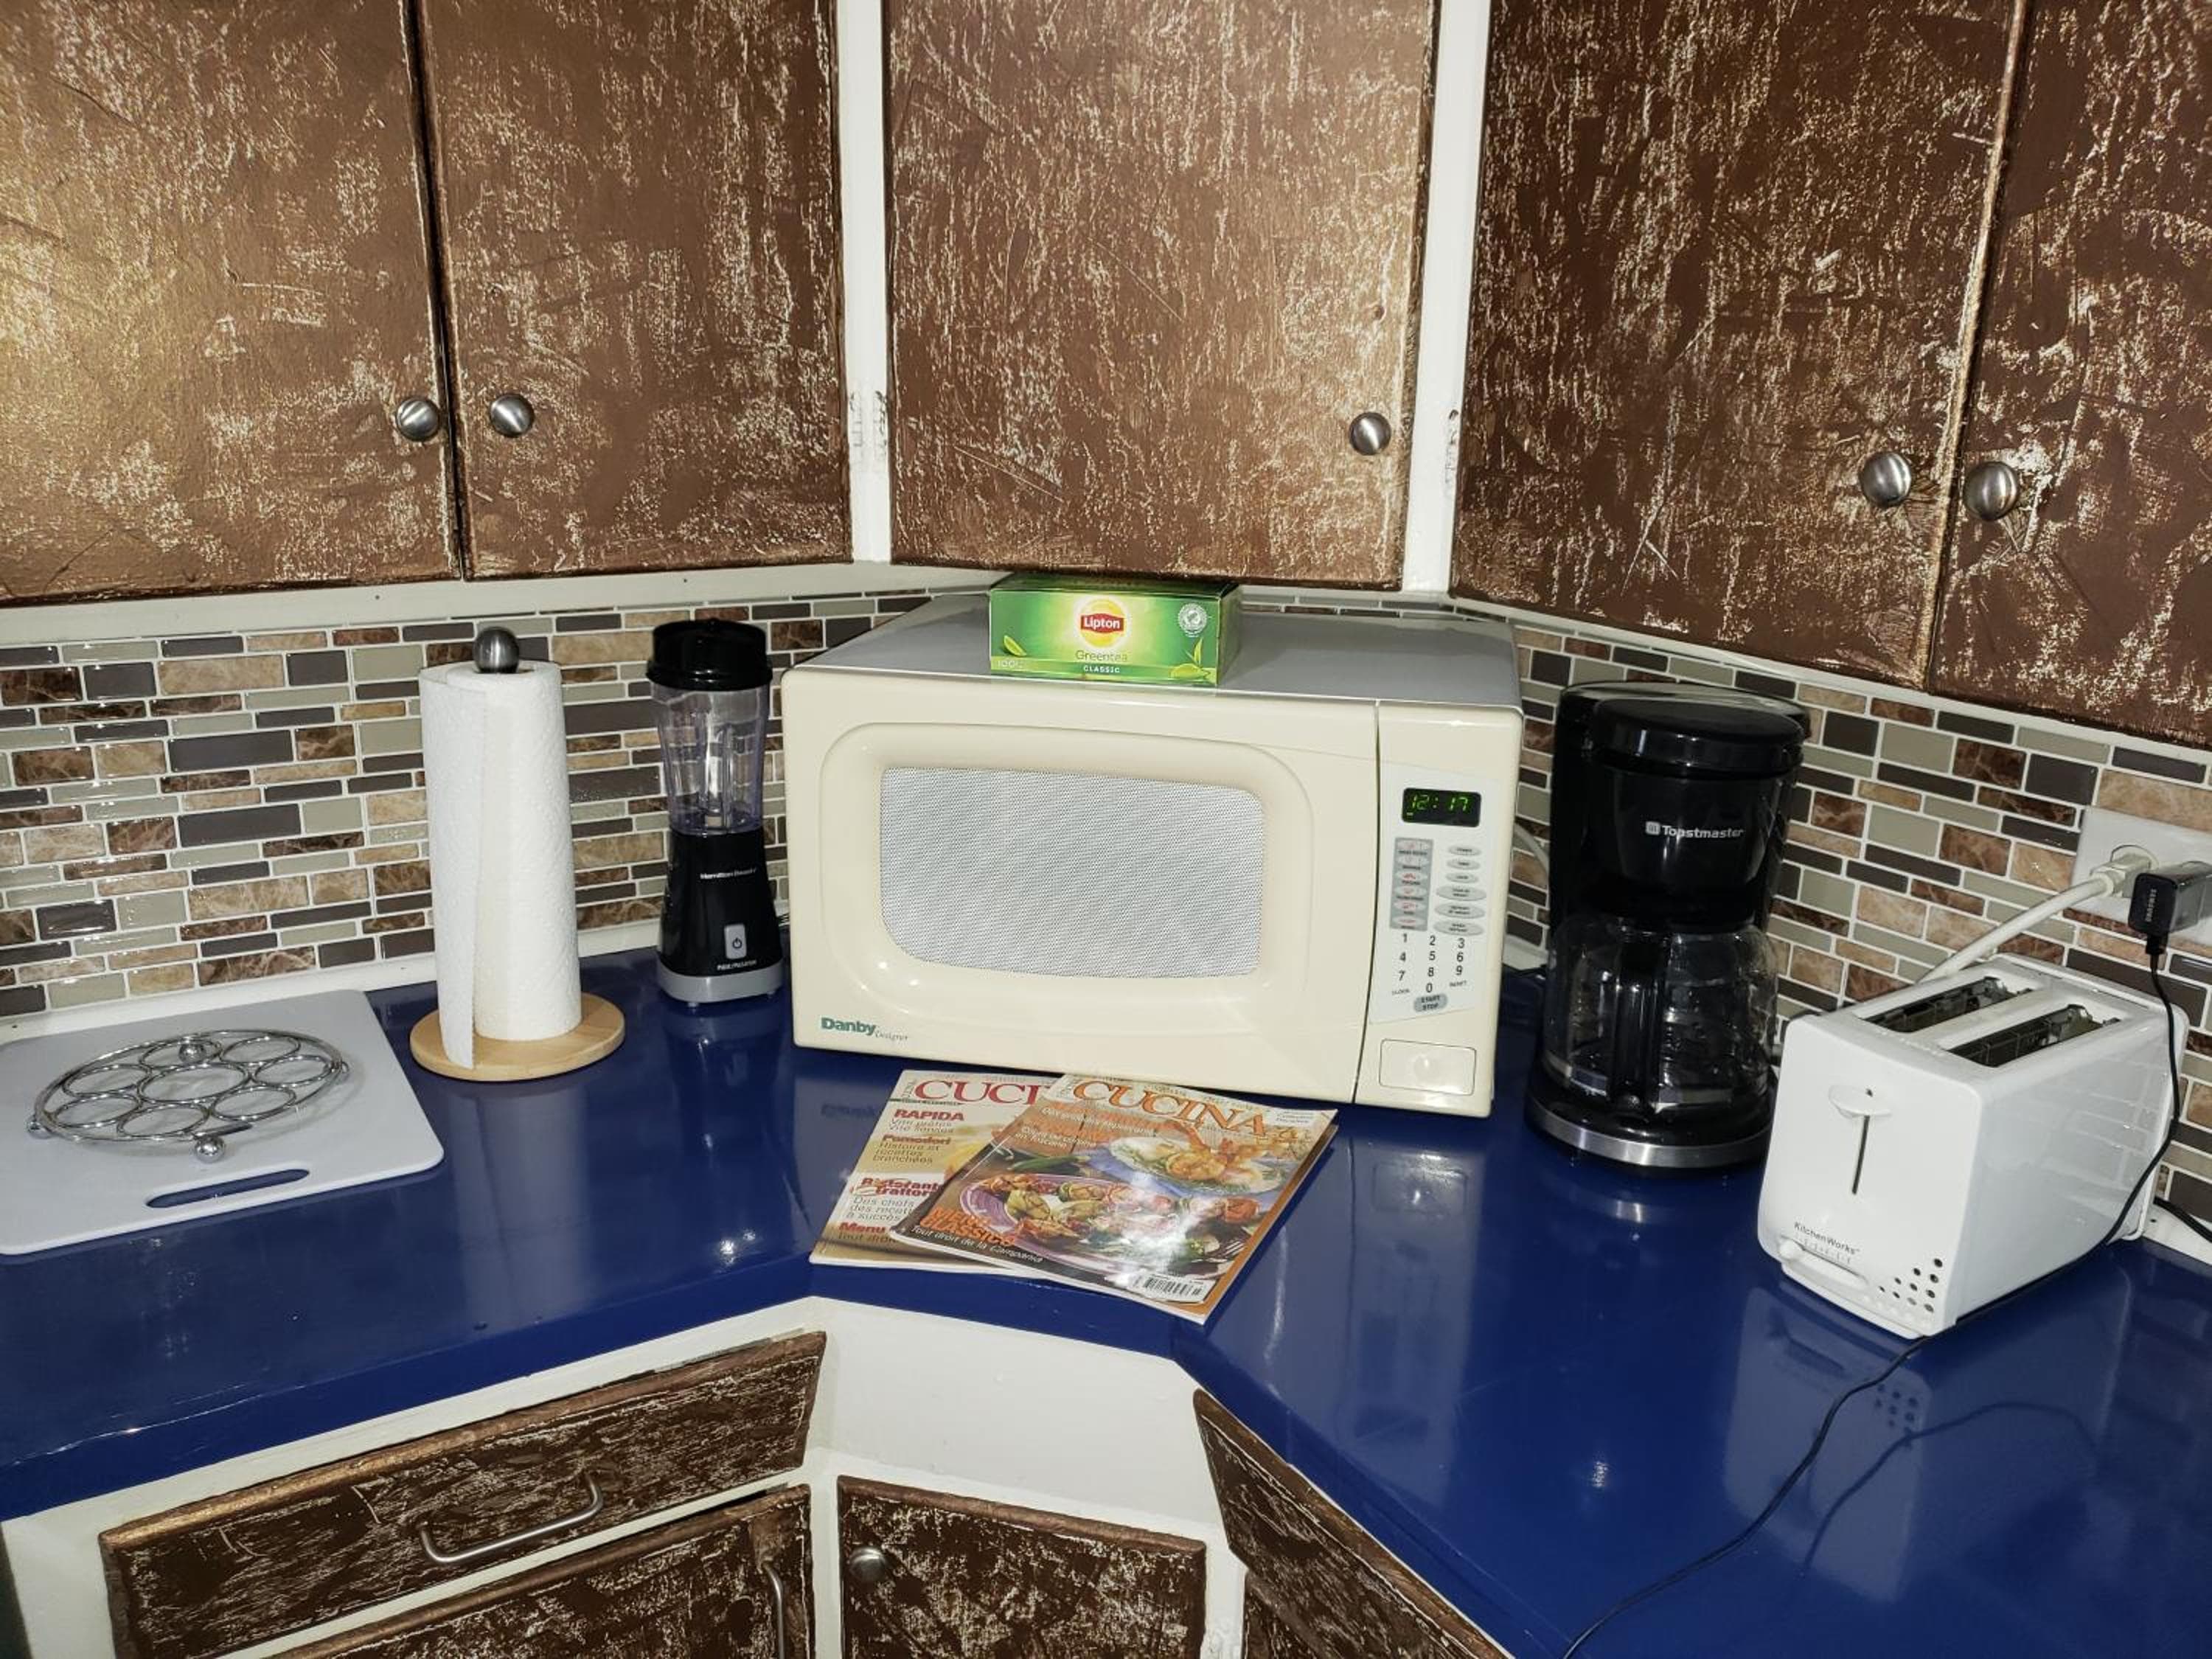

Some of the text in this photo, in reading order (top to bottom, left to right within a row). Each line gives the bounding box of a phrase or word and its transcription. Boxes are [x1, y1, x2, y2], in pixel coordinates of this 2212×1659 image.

[1083, 616, 1121, 630] Lipton
[1082, 664, 1121, 674] CLASSIC
[1661, 824, 1745, 839] Toastmaster
[1402, 933, 1466, 949] 1 2 3
[1399, 950, 1464, 962] 4 5 6
[1399, 965, 1463, 981] 7 8 9
[1425, 982, 1433, 993] 0
[821, 1017, 876, 1036] Danby
[914, 1079, 1043, 1105] CUCI
[894, 1108, 965, 1121] RAPIDA
[1073, 1080, 1267, 1137] CUCINA
[838, 1222, 886, 1234] Menu
[1793, 1221, 1857, 1256] KitchenWorks
